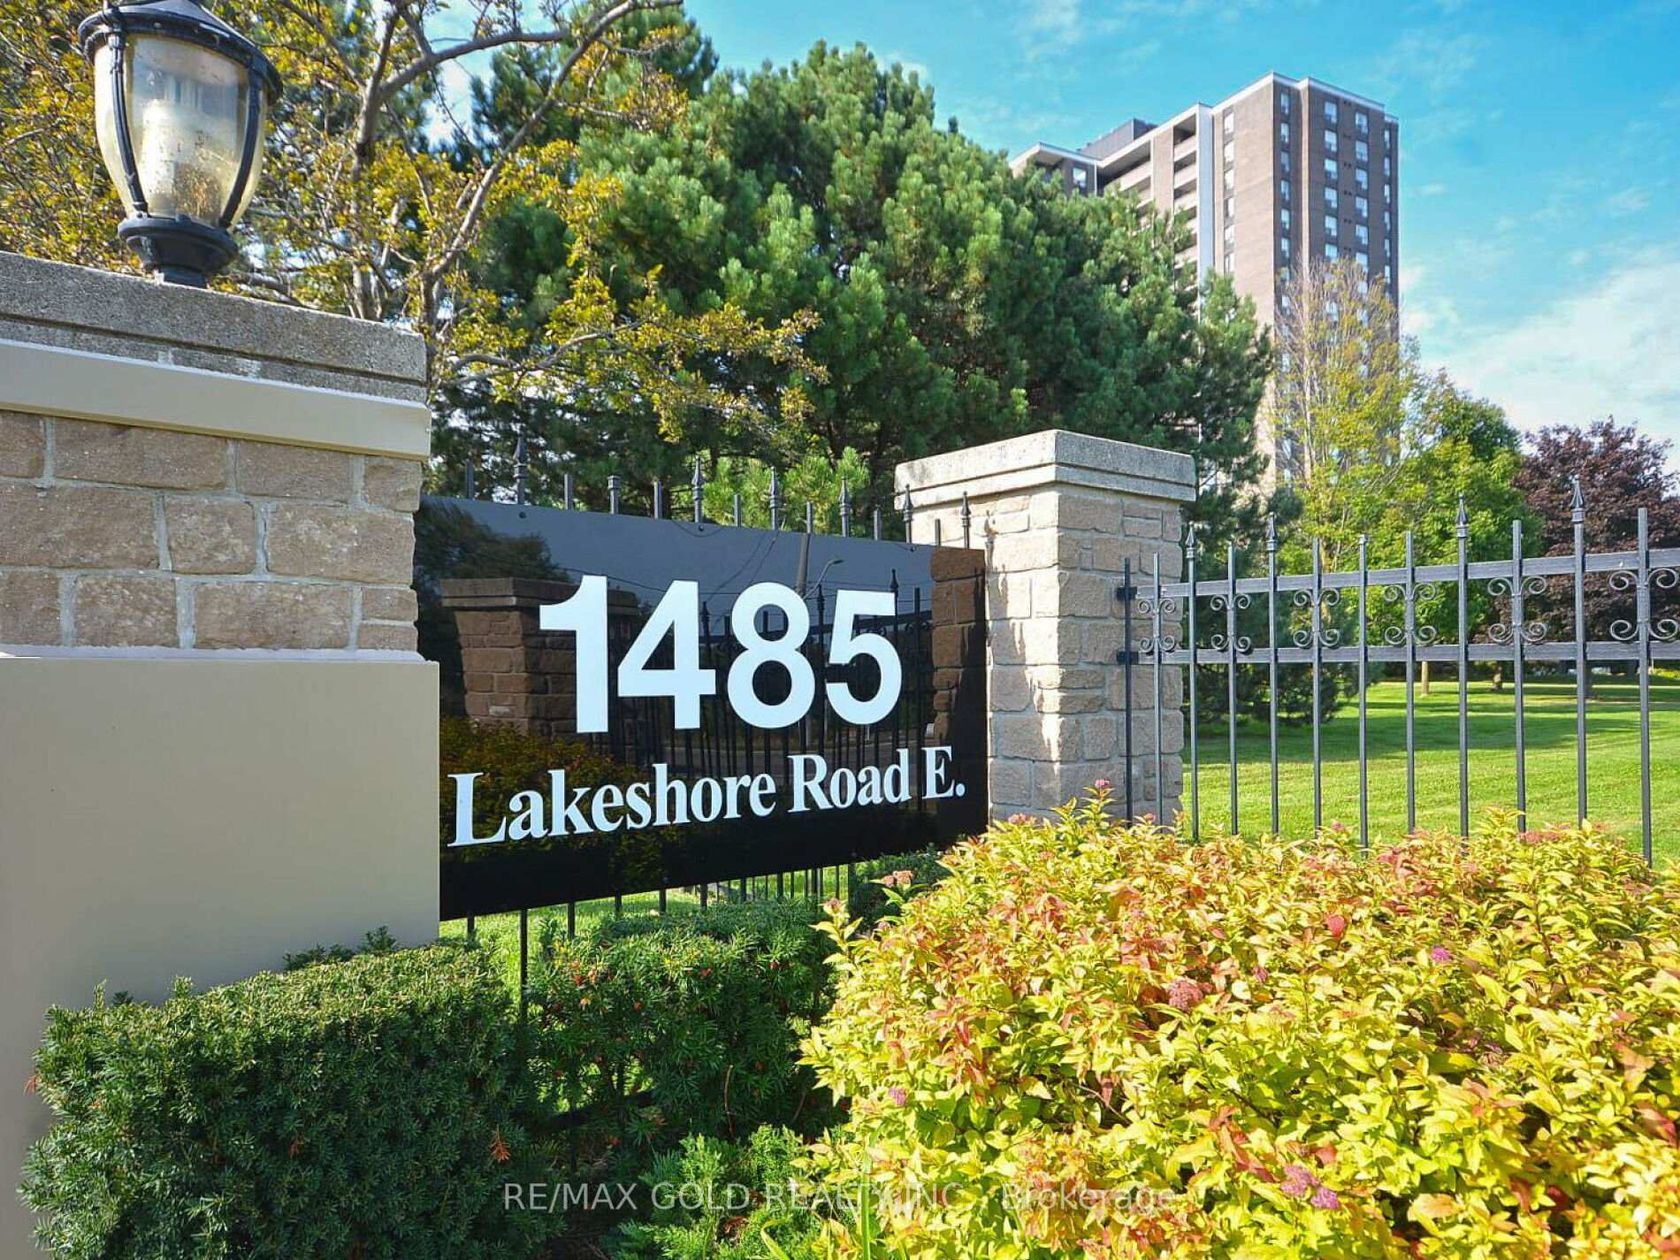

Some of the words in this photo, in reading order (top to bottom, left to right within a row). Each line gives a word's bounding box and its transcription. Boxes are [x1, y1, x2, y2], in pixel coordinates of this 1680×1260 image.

[539, 575, 902, 734] 1485
[447, 763, 777, 847] Lakeshore
[787, 749, 912, 812] Road
[923, 746, 966, 801] E.
